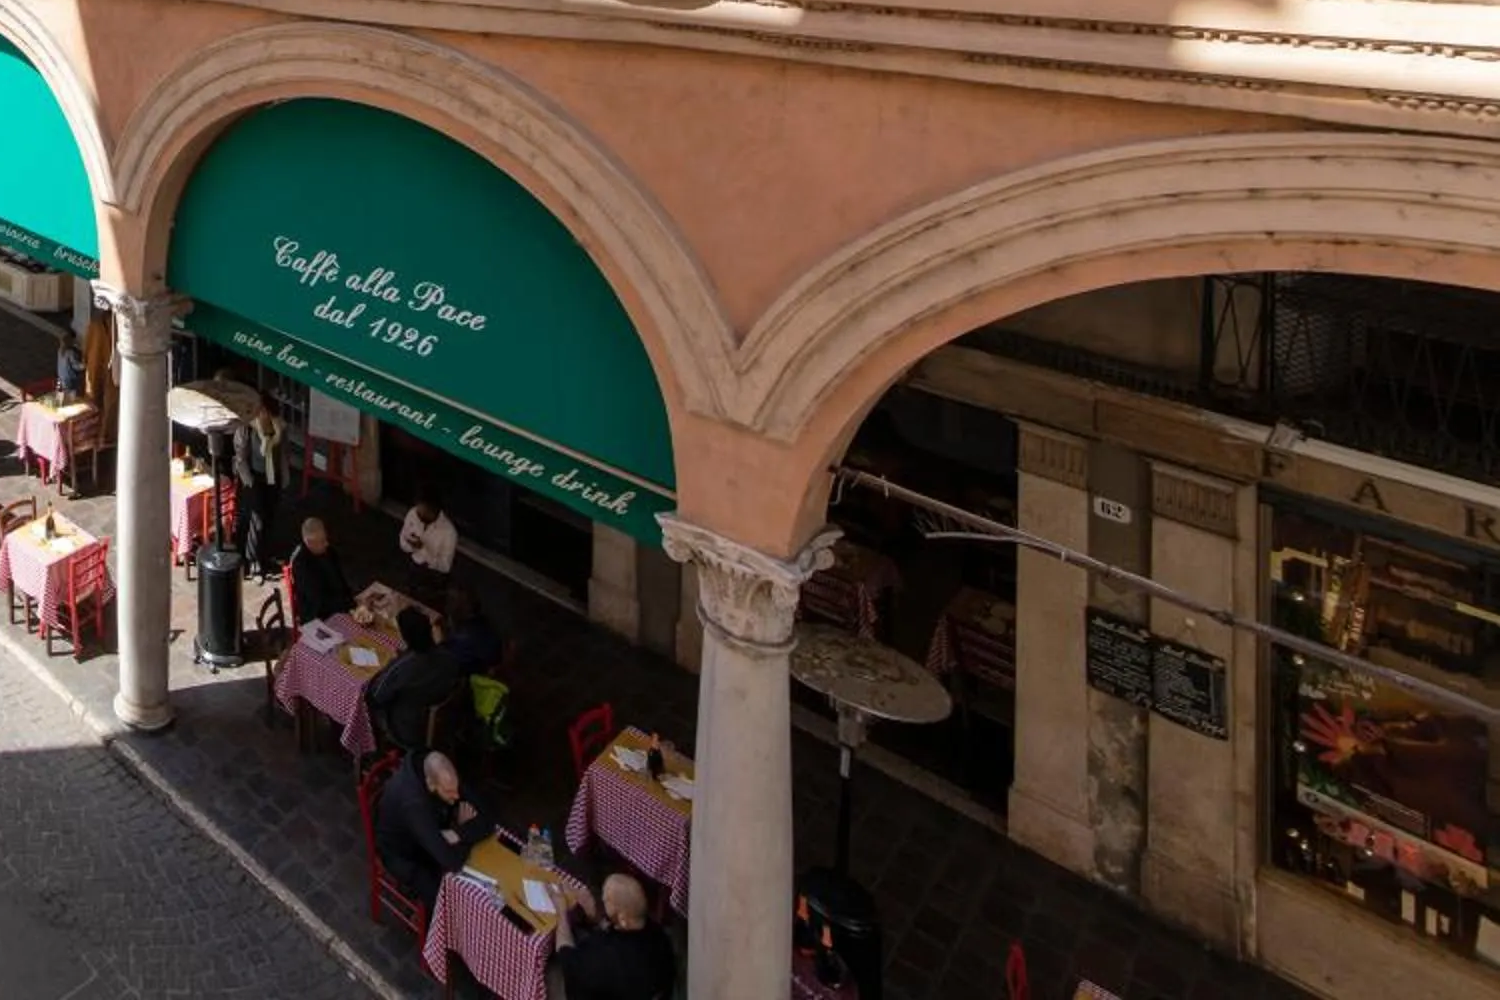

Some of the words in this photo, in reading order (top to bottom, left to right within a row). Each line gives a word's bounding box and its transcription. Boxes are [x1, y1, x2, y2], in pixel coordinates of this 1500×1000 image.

[53, 245, 99, 273] brusch
[273, 235, 341, 287] Caffè
[345, 267, 400, 303] alla
[408, 281, 487, 330] Pace
[313, 296, 367, 329] dal
[369, 317, 439, 356] 1926
[233, 331, 273, 356] wine
[276, 343, 309, 370] bar
[325, 373, 437, 430] restaurant
[458, 425, 545, 477] lounge
[551, 468, 637, 515] drink
